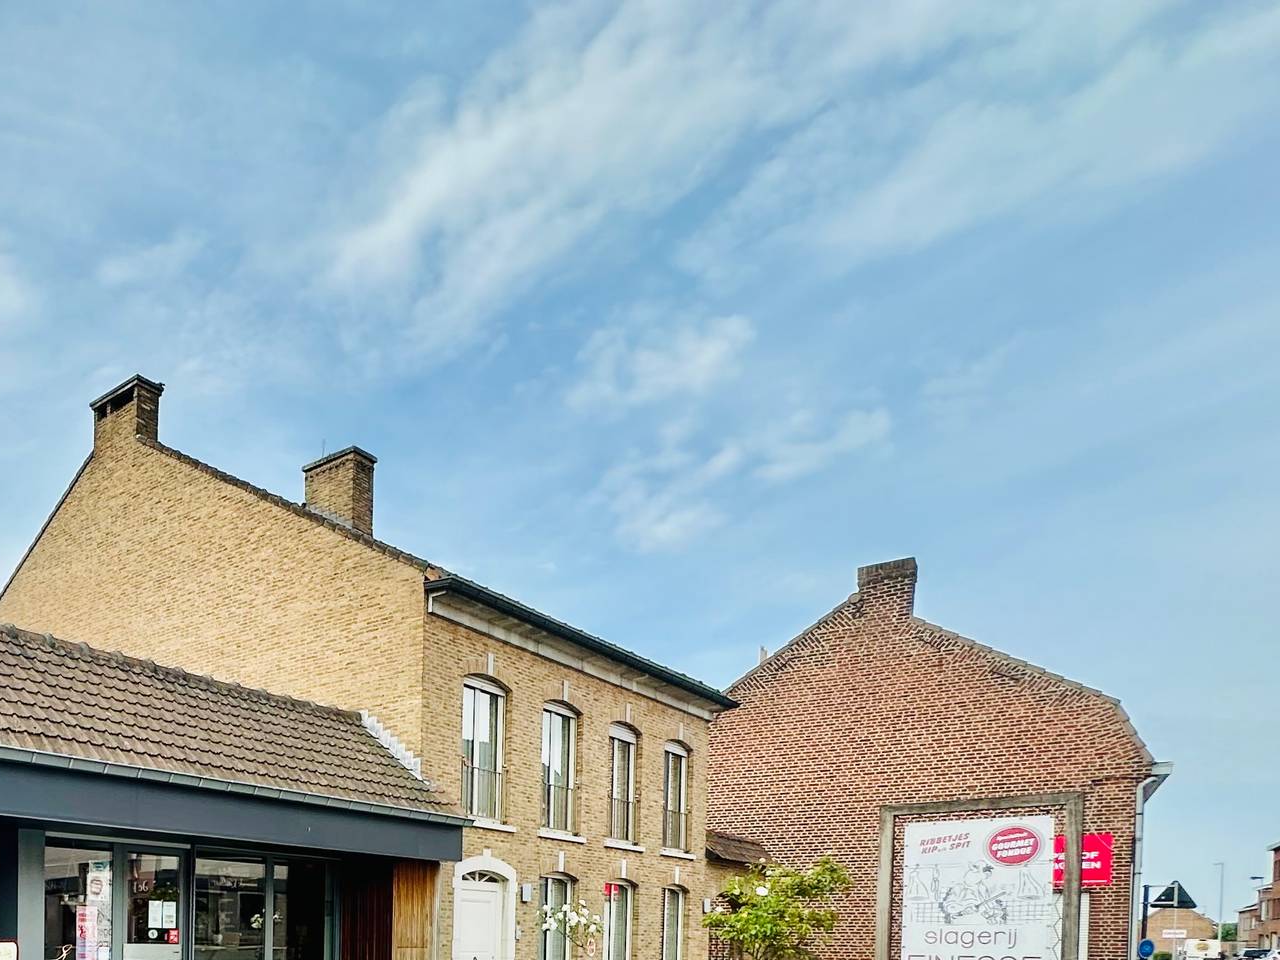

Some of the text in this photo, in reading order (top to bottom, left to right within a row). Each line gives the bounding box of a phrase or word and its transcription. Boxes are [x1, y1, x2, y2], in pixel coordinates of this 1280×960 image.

[920, 832, 970, 846] RIBBETJES
[992, 838, 1035, 851] GOURMET
[921, 845, 938, 854] KIP
[949, 840, 972, 850] SPIT
[924, 928, 1017, 949] slagerij
